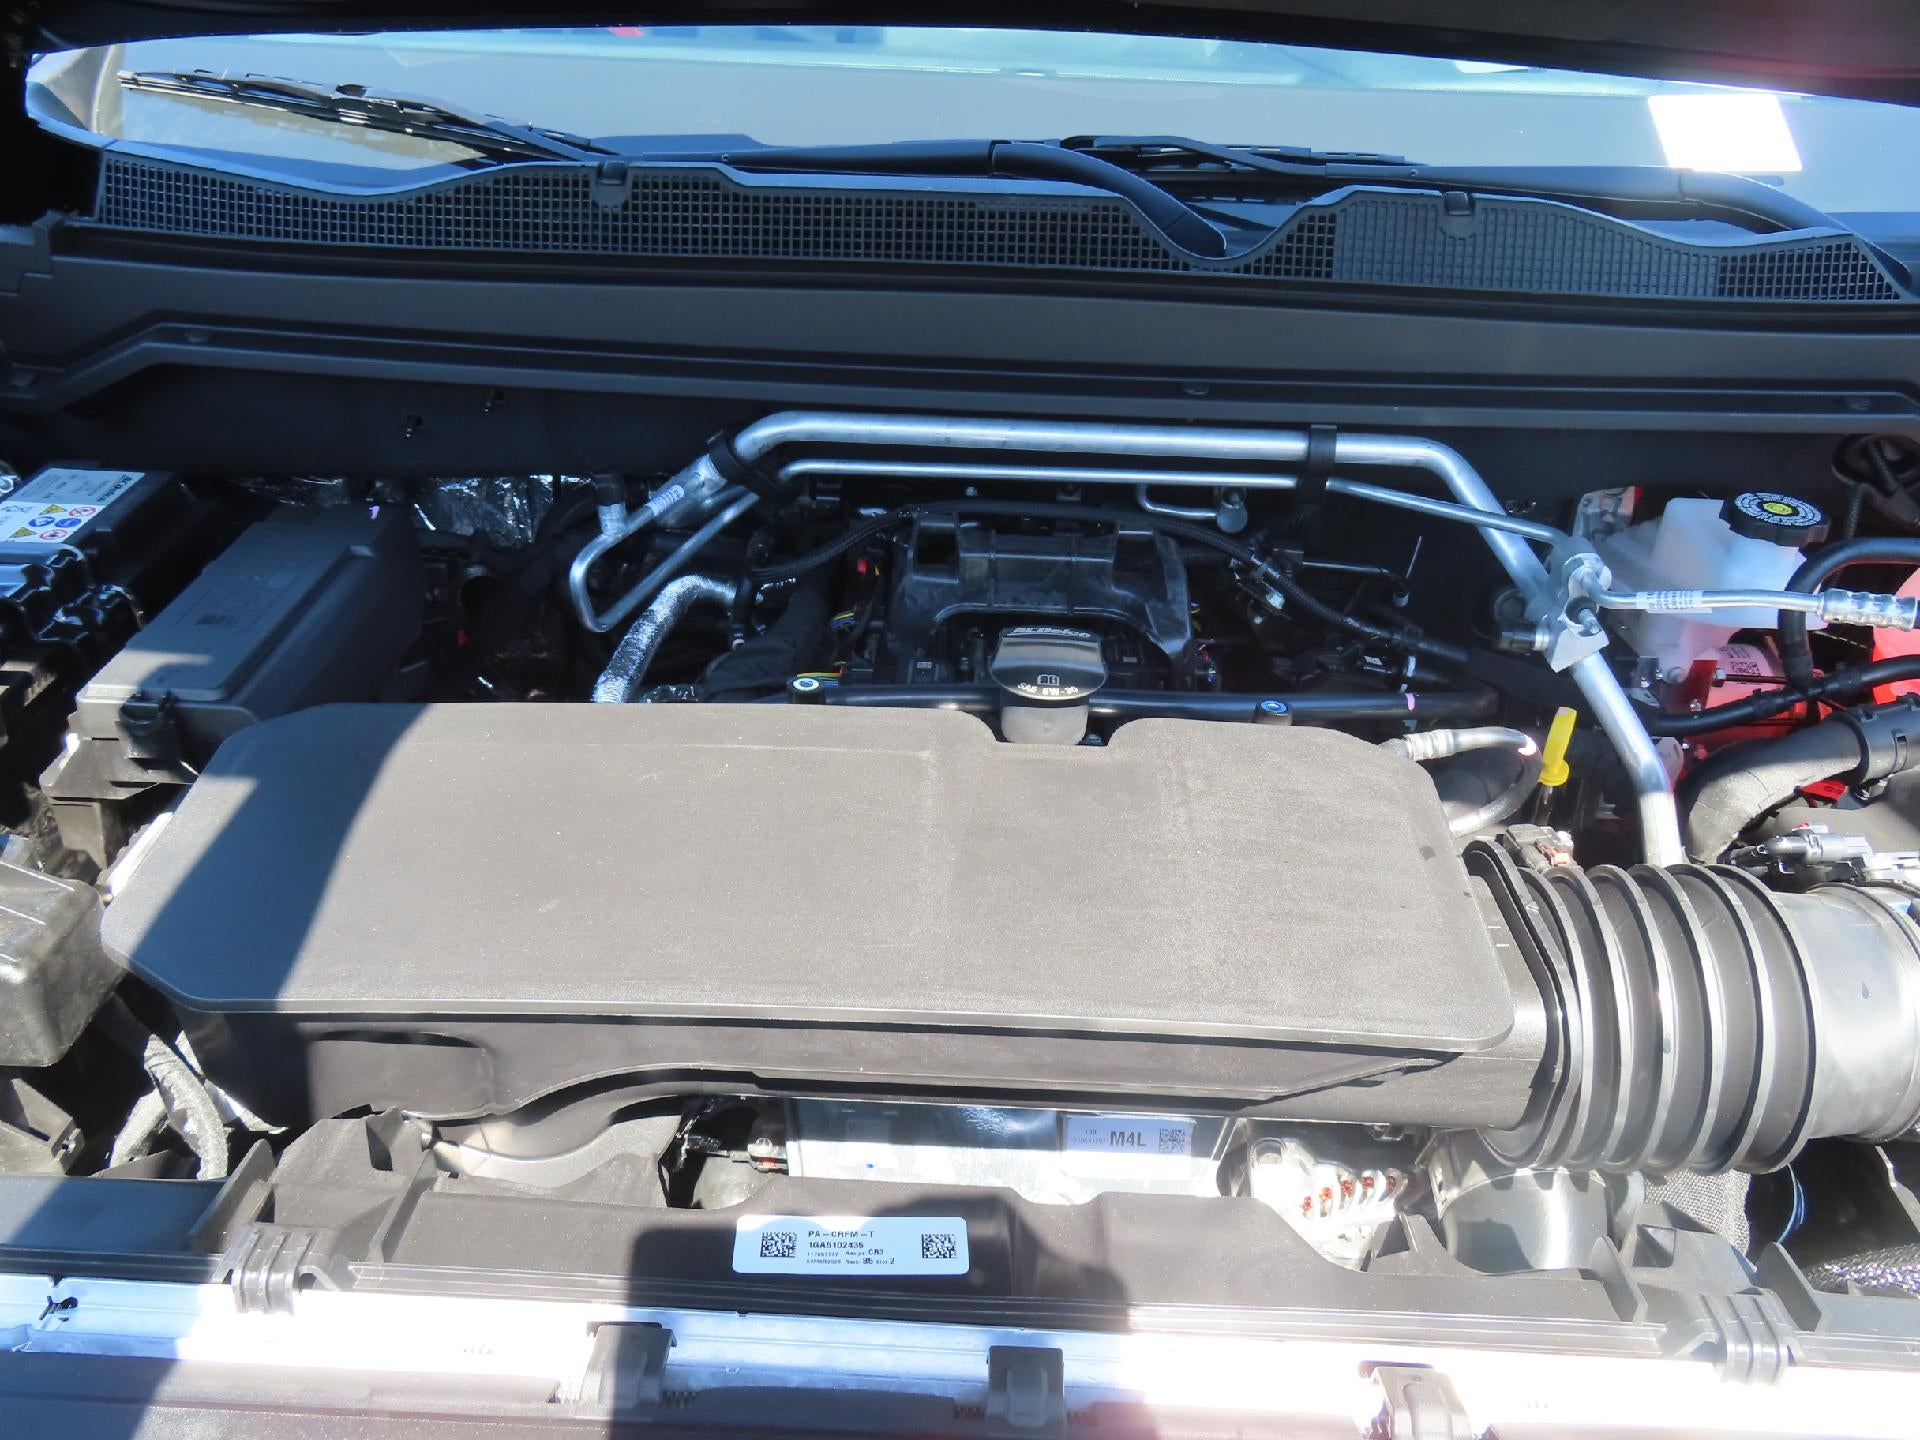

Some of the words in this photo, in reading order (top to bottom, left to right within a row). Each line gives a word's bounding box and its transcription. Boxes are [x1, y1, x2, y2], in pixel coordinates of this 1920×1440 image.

[1007, 628, 1091, 637] ACDelco
[1018, 683, 1038, 693] SAE
[1110, 1131, 1146, 1146] M4L
[868, 1248, 884, 1256] CR3
[890, 1257, 896, 1265] 2
